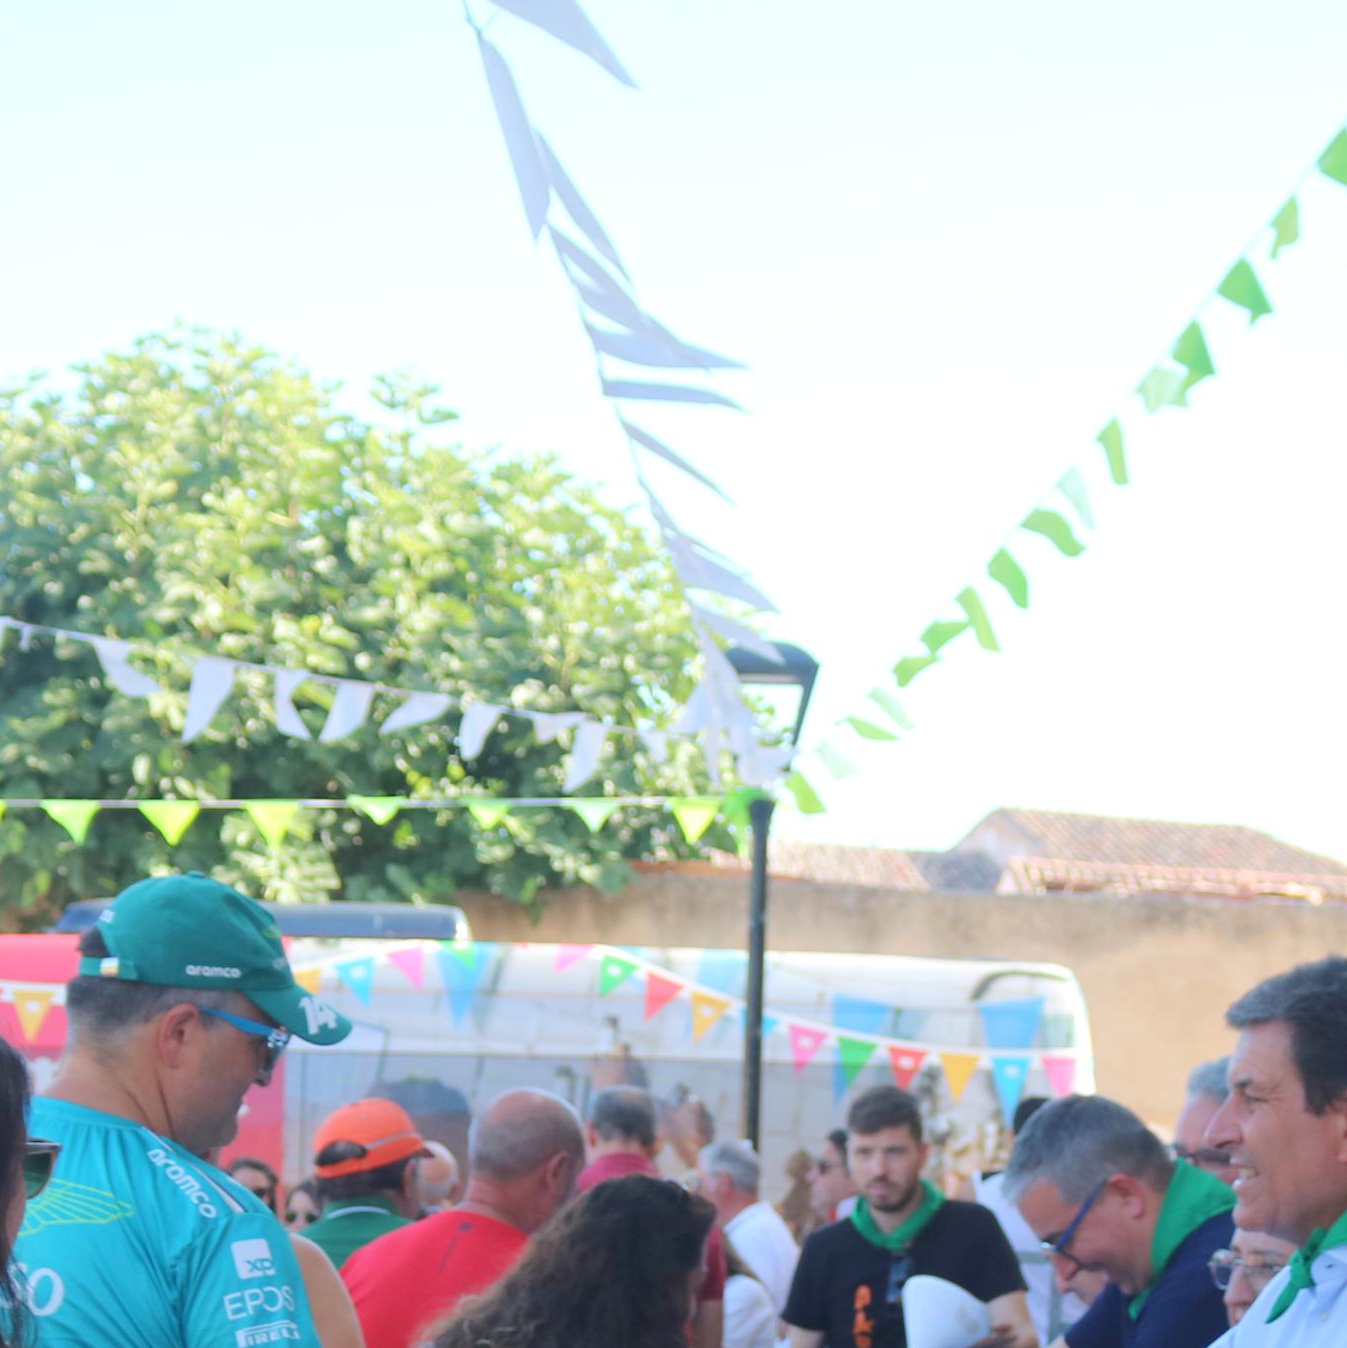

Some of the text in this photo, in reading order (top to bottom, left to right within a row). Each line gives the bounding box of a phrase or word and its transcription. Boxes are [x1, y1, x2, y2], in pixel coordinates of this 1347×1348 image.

[185, 963, 242, 979] aramco
[299, 996, 338, 1036] 14
[147, 1148, 218, 1219] aramco
